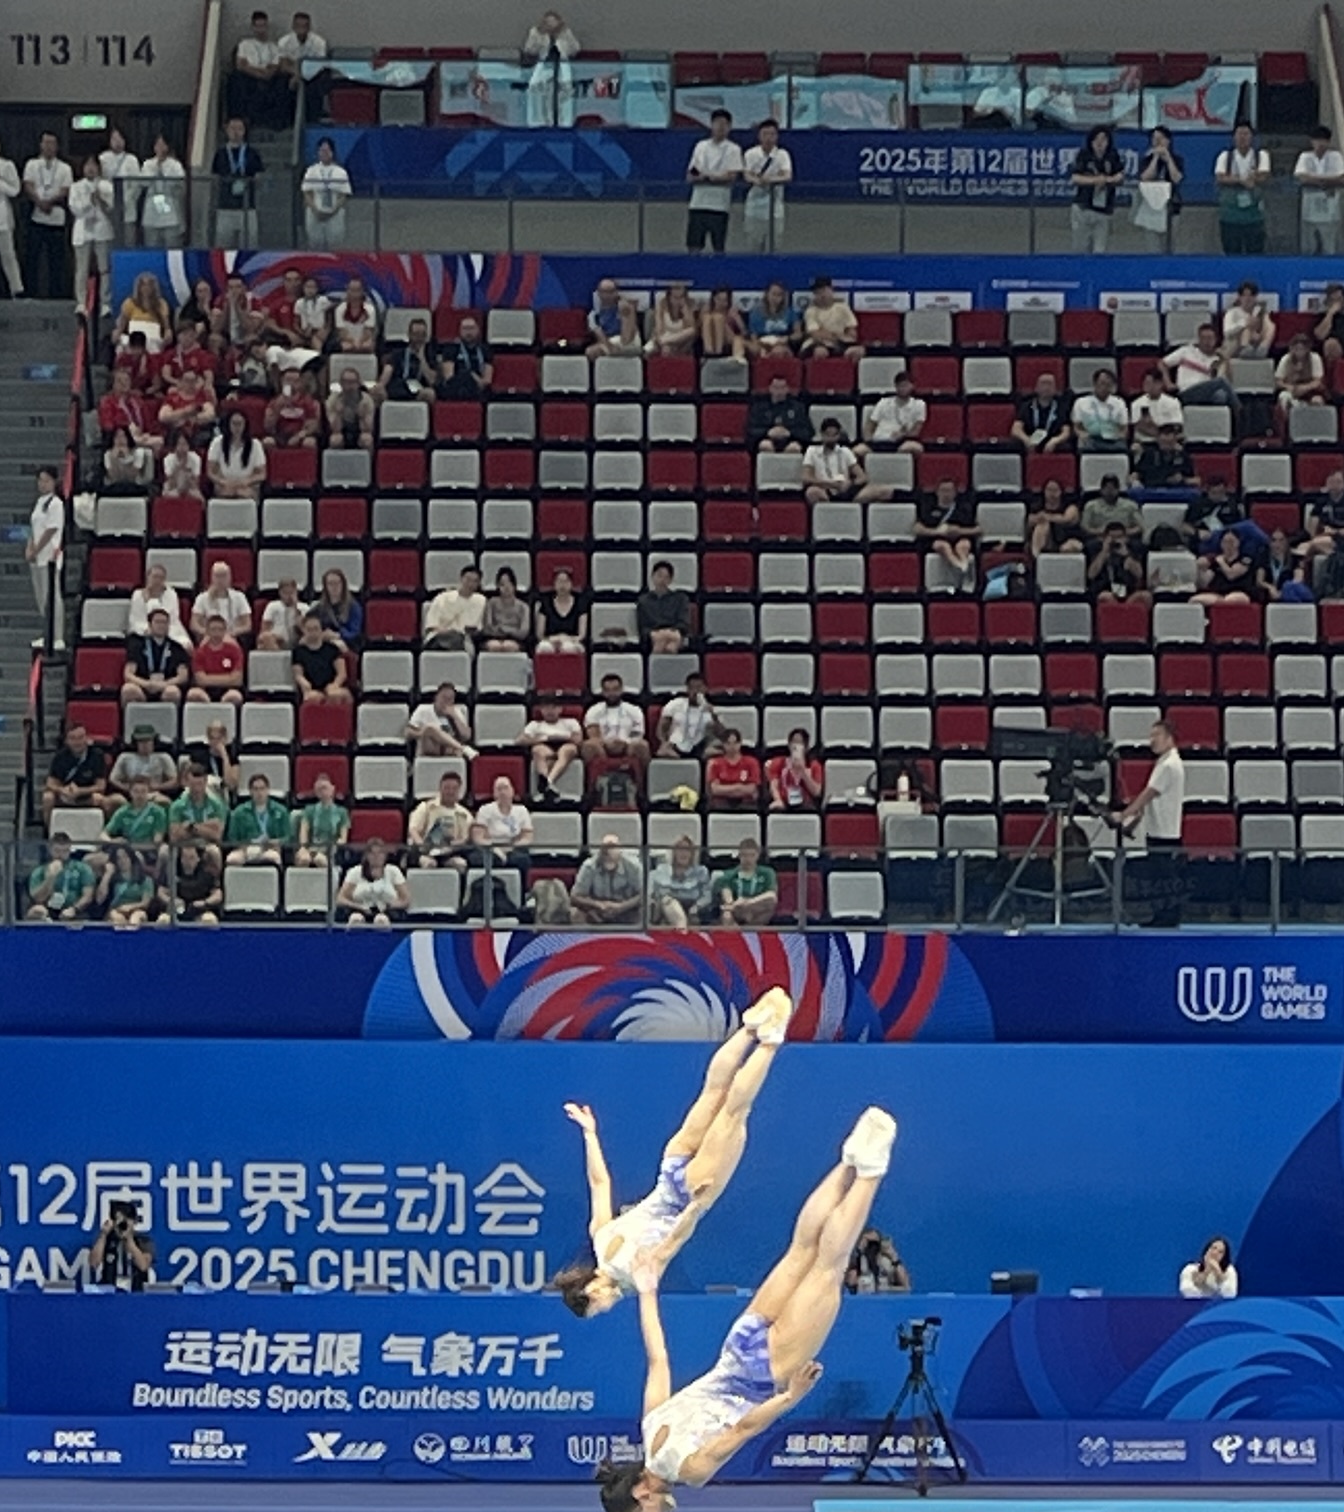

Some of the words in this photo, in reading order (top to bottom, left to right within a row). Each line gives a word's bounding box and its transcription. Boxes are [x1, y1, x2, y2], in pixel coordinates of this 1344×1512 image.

[11, 34, 70, 65] 113
[96, 34, 155, 66] 114
[1263, 966, 1296, 983] THE
[1262, 984, 1327, 1001] WORLD
[1261, 1002, 1325, 1019] GAMES
[167, 1248, 296, 1292] 2025
[308, 1249, 546, 1293] CHENGDU
[164, 1328, 362, 1377] 运动无限
[381, 1331, 564, 1377] 气象万千
[132, 1382, 261, 1409] Boundless
[266, 1384, 353, 1413] Sports,
[358, 1385, 480, 1411] Countless
[486, 1385, 594, 1412] Wonders
[54, 1430, 96, 1447] PICC
[169, 1443, 247, 1459] TISSOT
